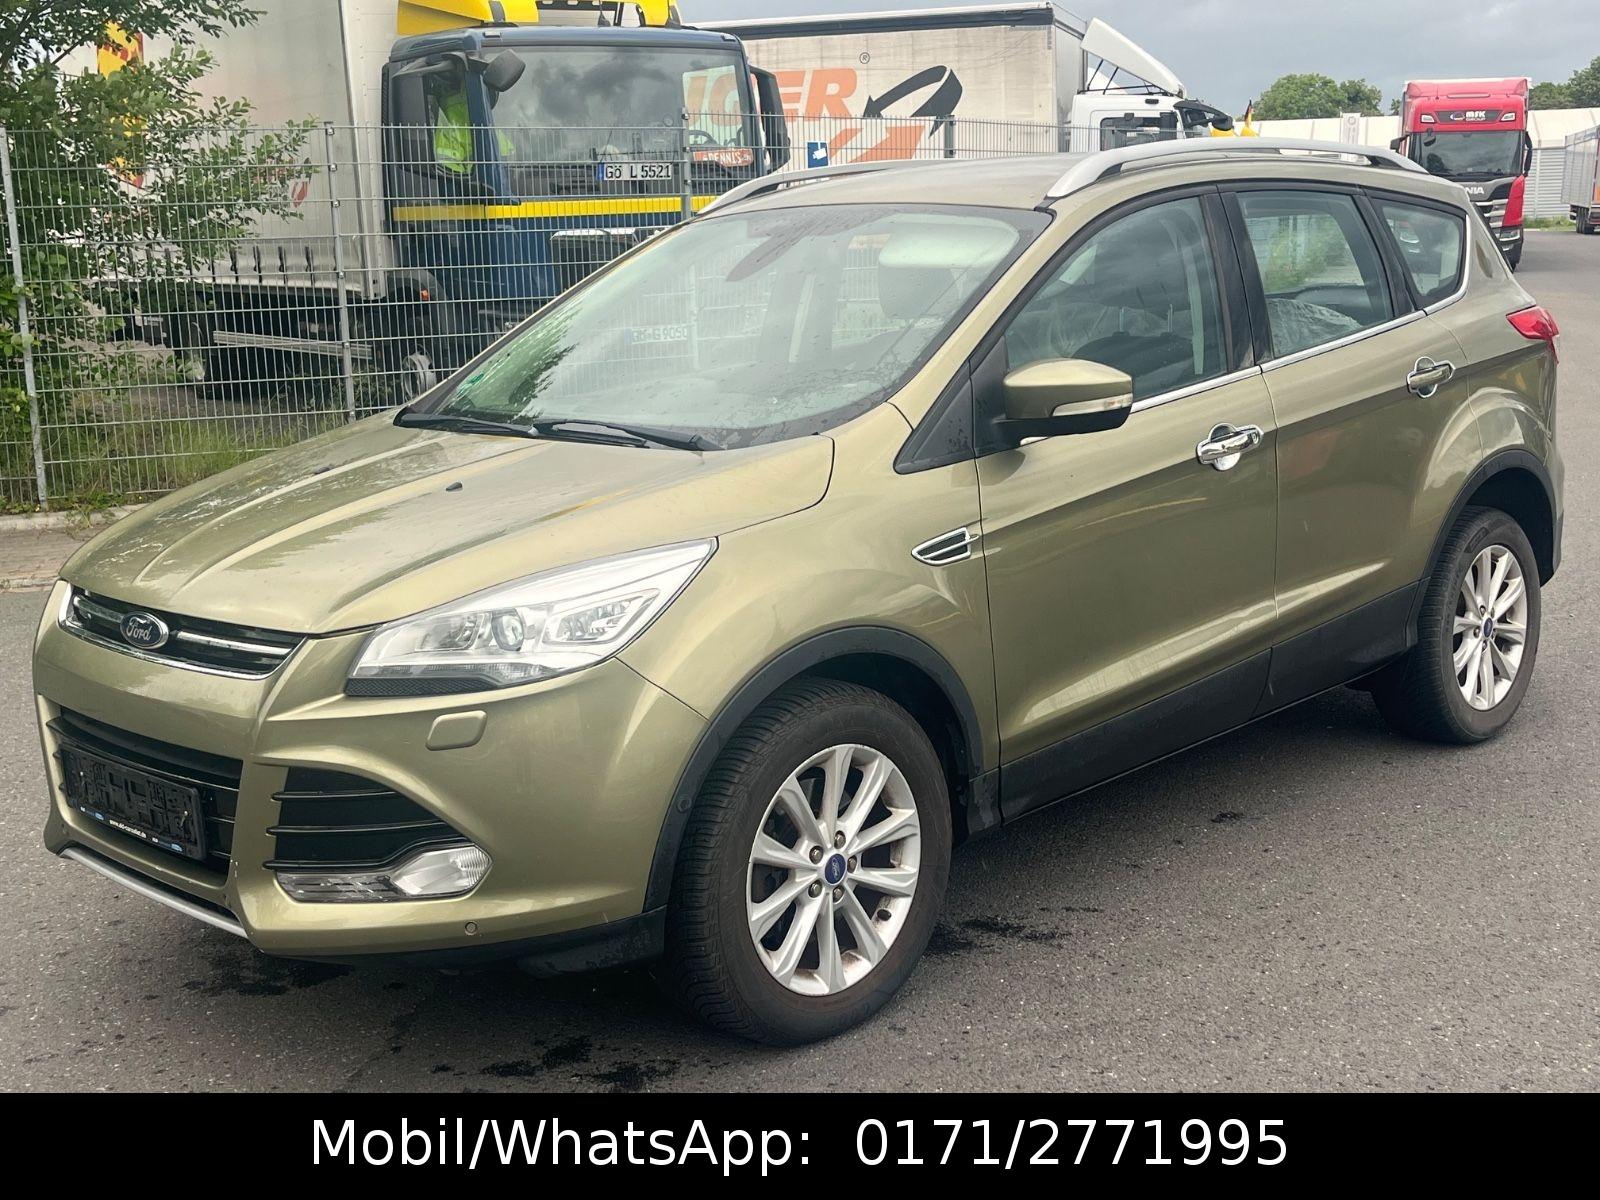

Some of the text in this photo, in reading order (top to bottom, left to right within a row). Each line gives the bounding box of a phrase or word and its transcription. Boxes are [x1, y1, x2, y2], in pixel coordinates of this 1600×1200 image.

[605, 164, 671, 179] GÖ L 5521
[126, 616, 153, 641] Ford
